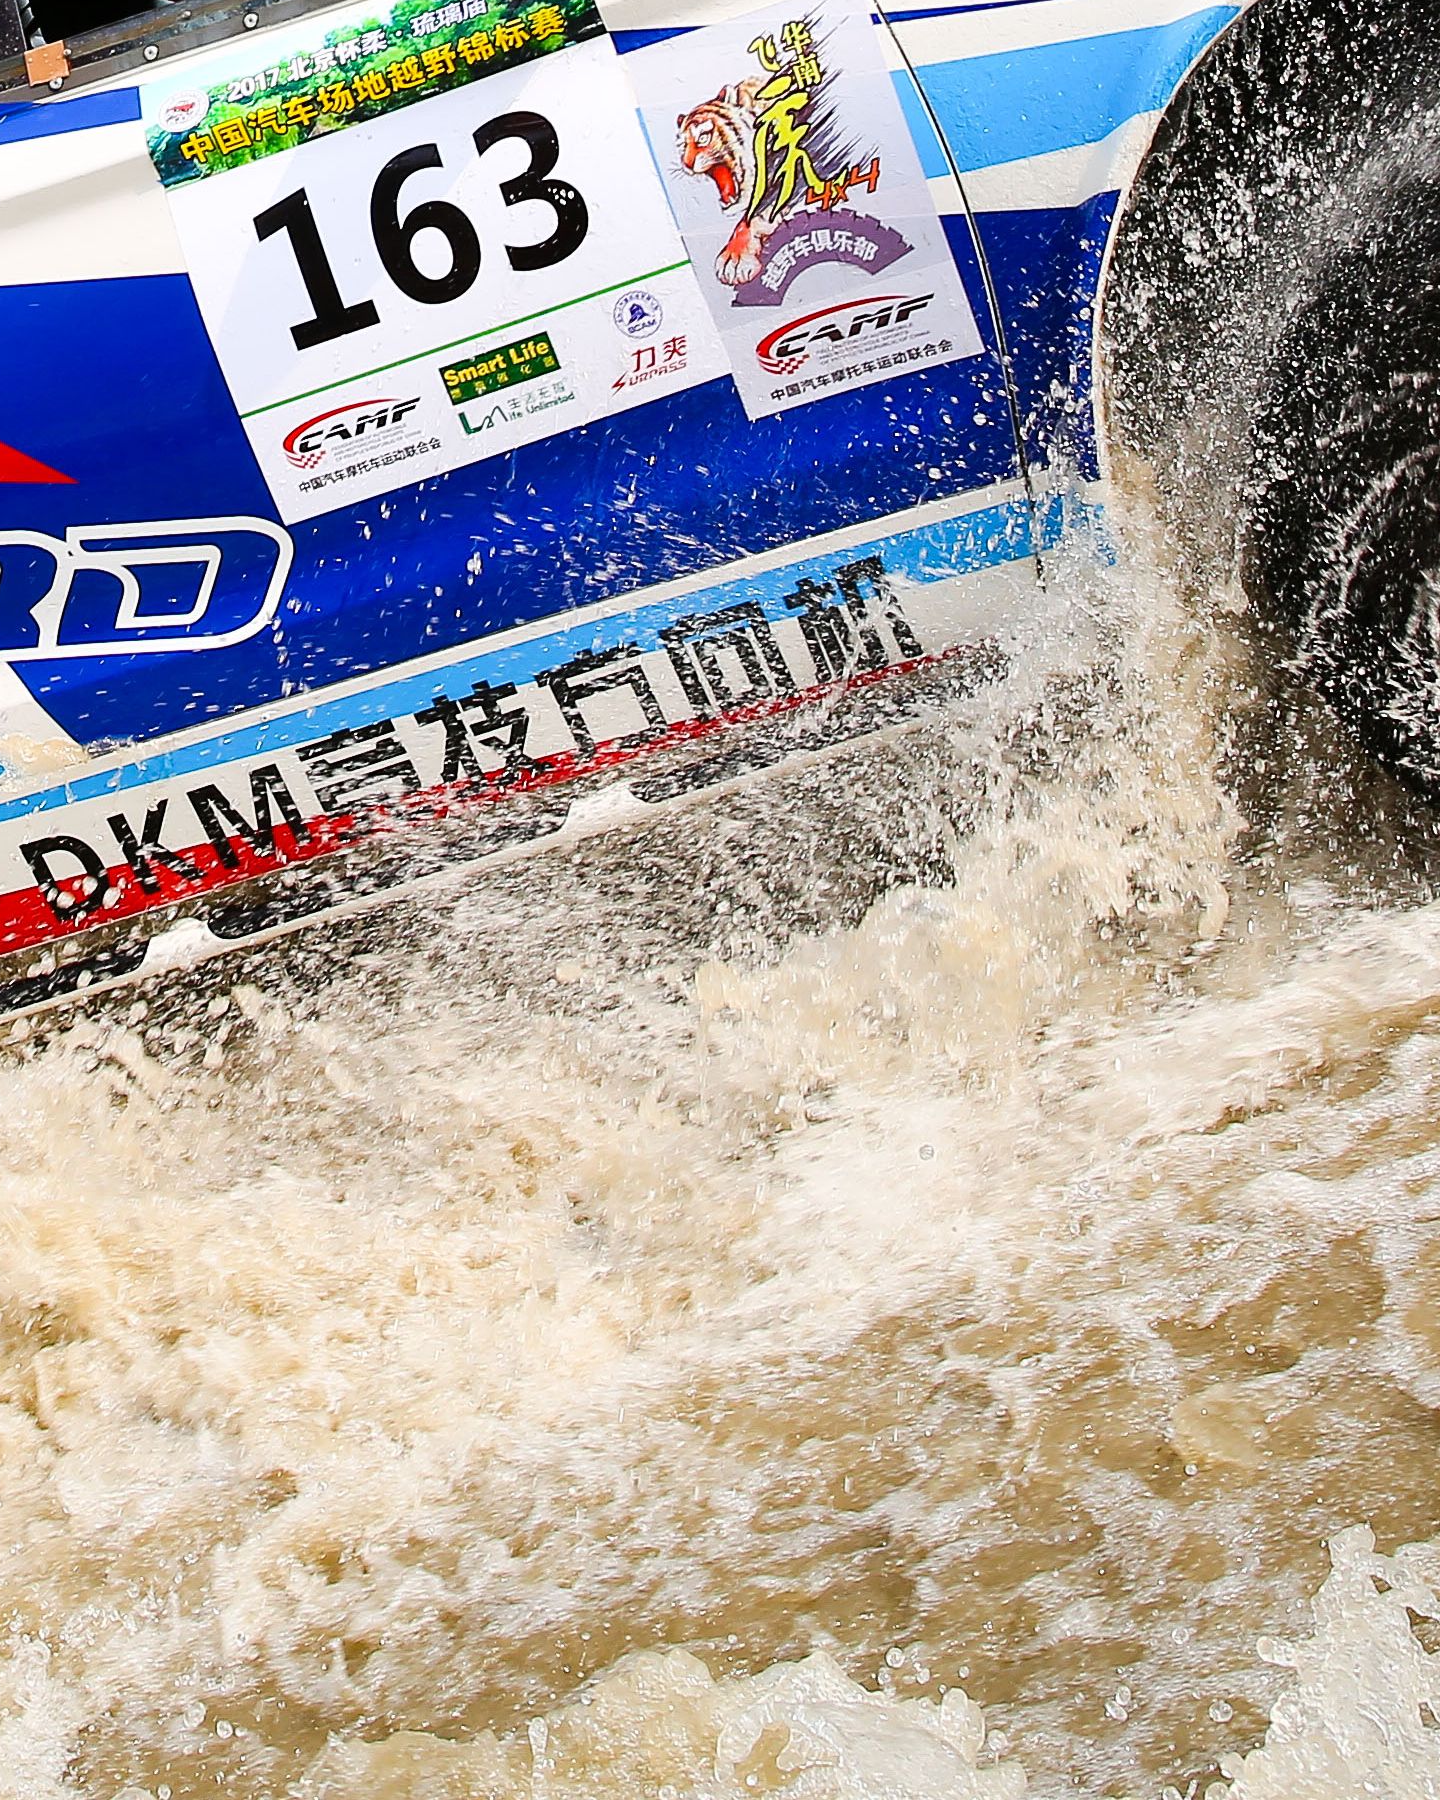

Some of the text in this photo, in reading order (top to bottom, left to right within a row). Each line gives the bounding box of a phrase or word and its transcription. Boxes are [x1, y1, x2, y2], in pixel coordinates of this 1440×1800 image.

[179, 4, 566, 165] 中国汽车场地越野锦标赛
[225, 69, 282, 104] 2017
[252, 110, 590, 351] 163
[760, 228, 880, 293] 越野车俱乐部
[631, 334, 687, 374] 力爽
[775, 292, 935, 358] CAMF
[443, 353, 507, 387] Smart
[509, 340, 549, 365] Life
[770, 338, 953, 401] 中国汽车摩托车运动联合会
[298, 396, 421, 453] CAMF
[298, 436, 442, 493] 中国汽车摩托车运动联合会
